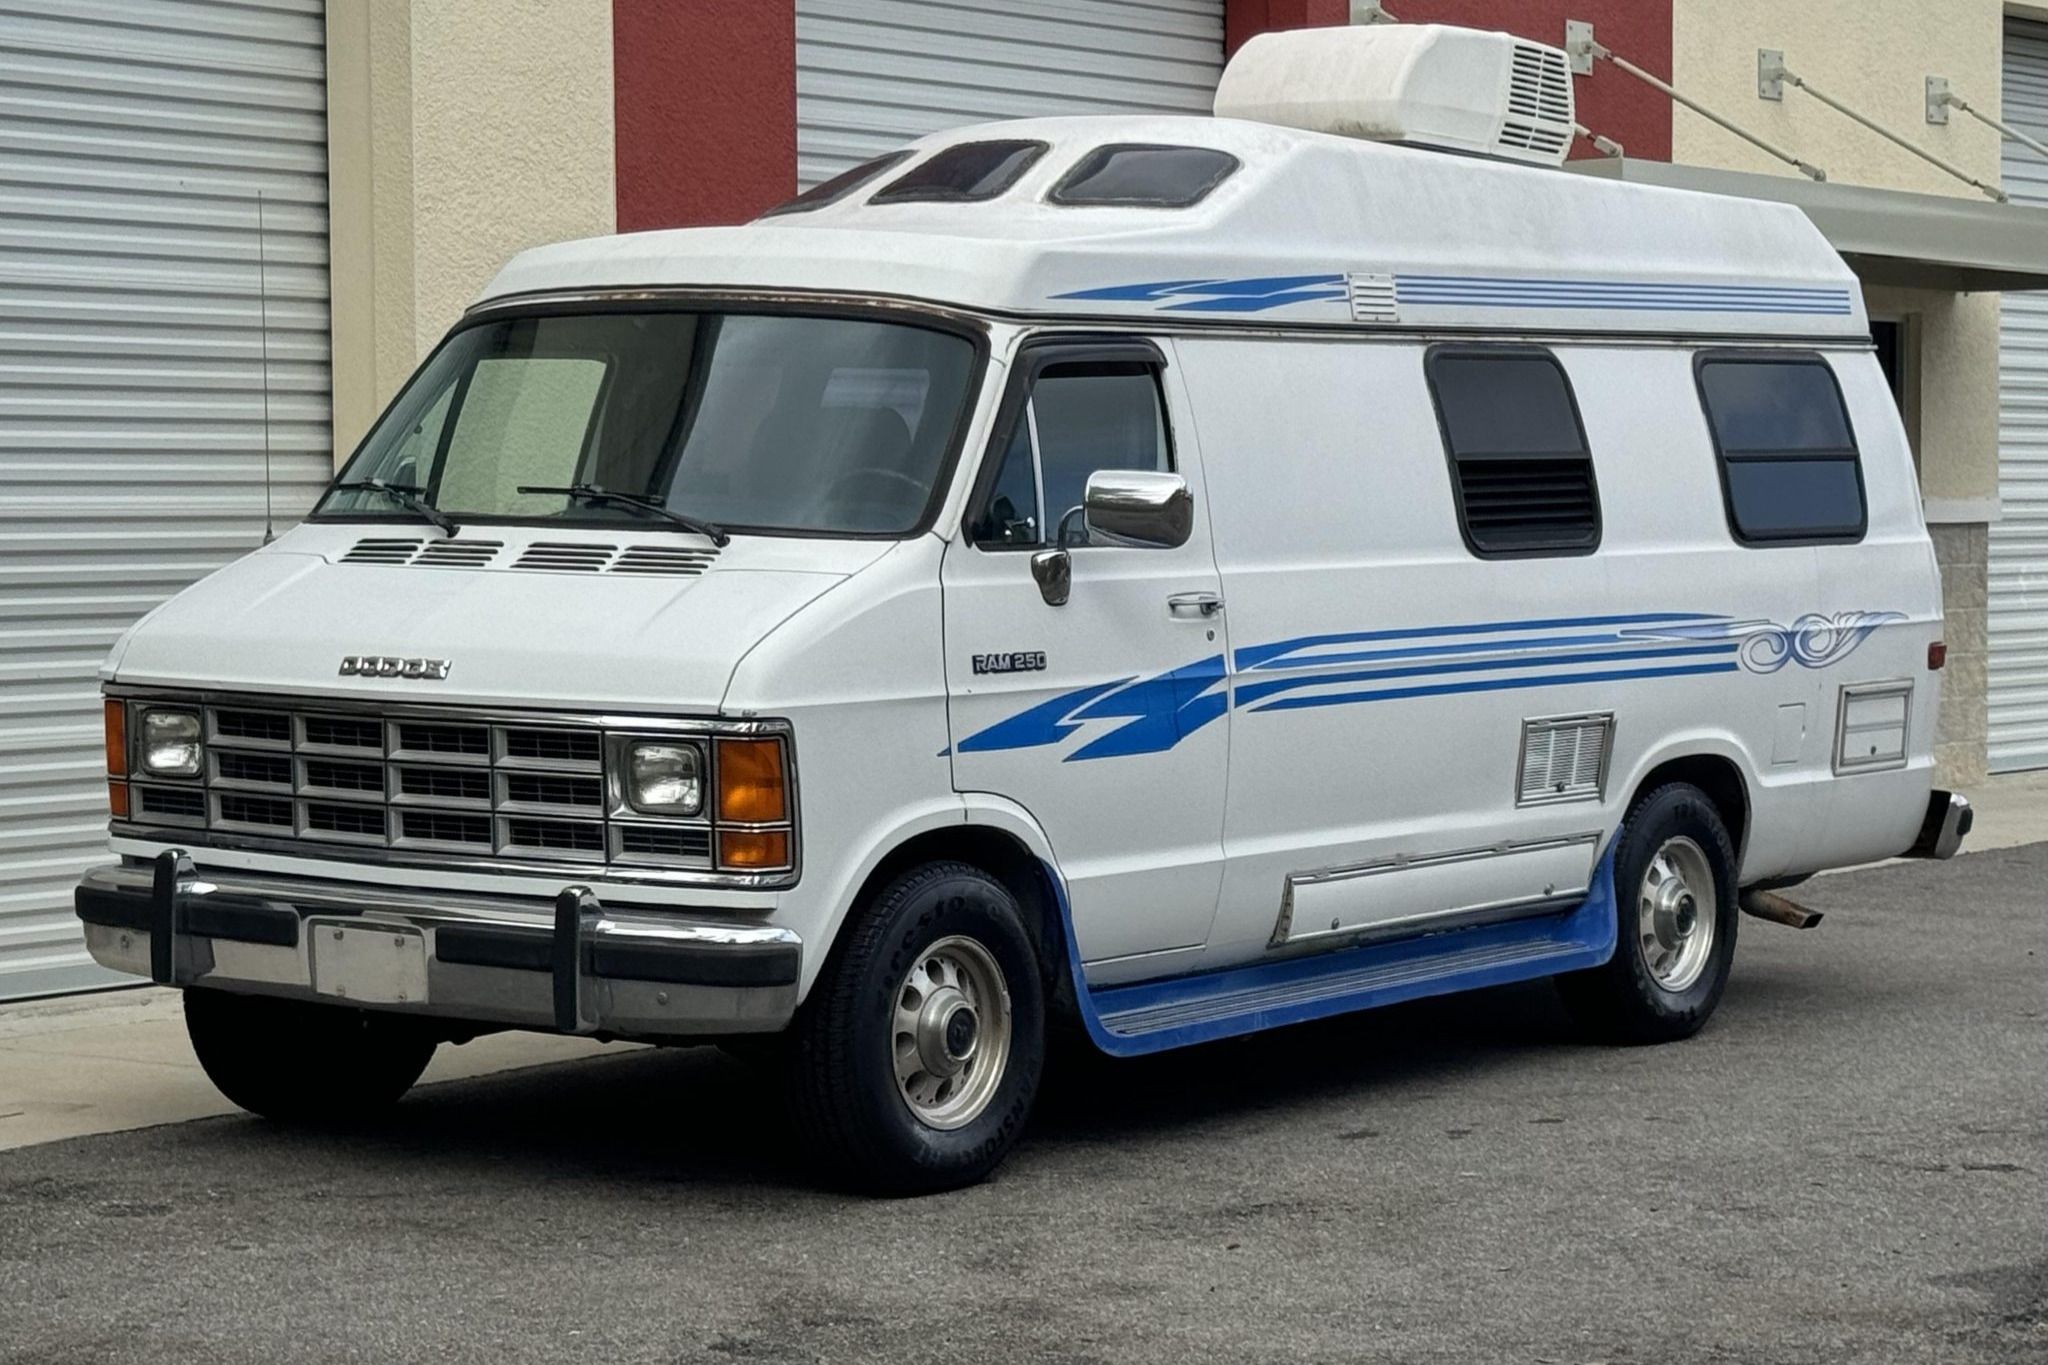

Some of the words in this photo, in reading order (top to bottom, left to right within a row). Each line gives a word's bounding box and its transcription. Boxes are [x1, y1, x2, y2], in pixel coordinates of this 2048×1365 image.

[339, 656, 451, 680] DODGE
[972, 653, 1011, 675] RAM
[1012, 651, 1047, 673] 250
